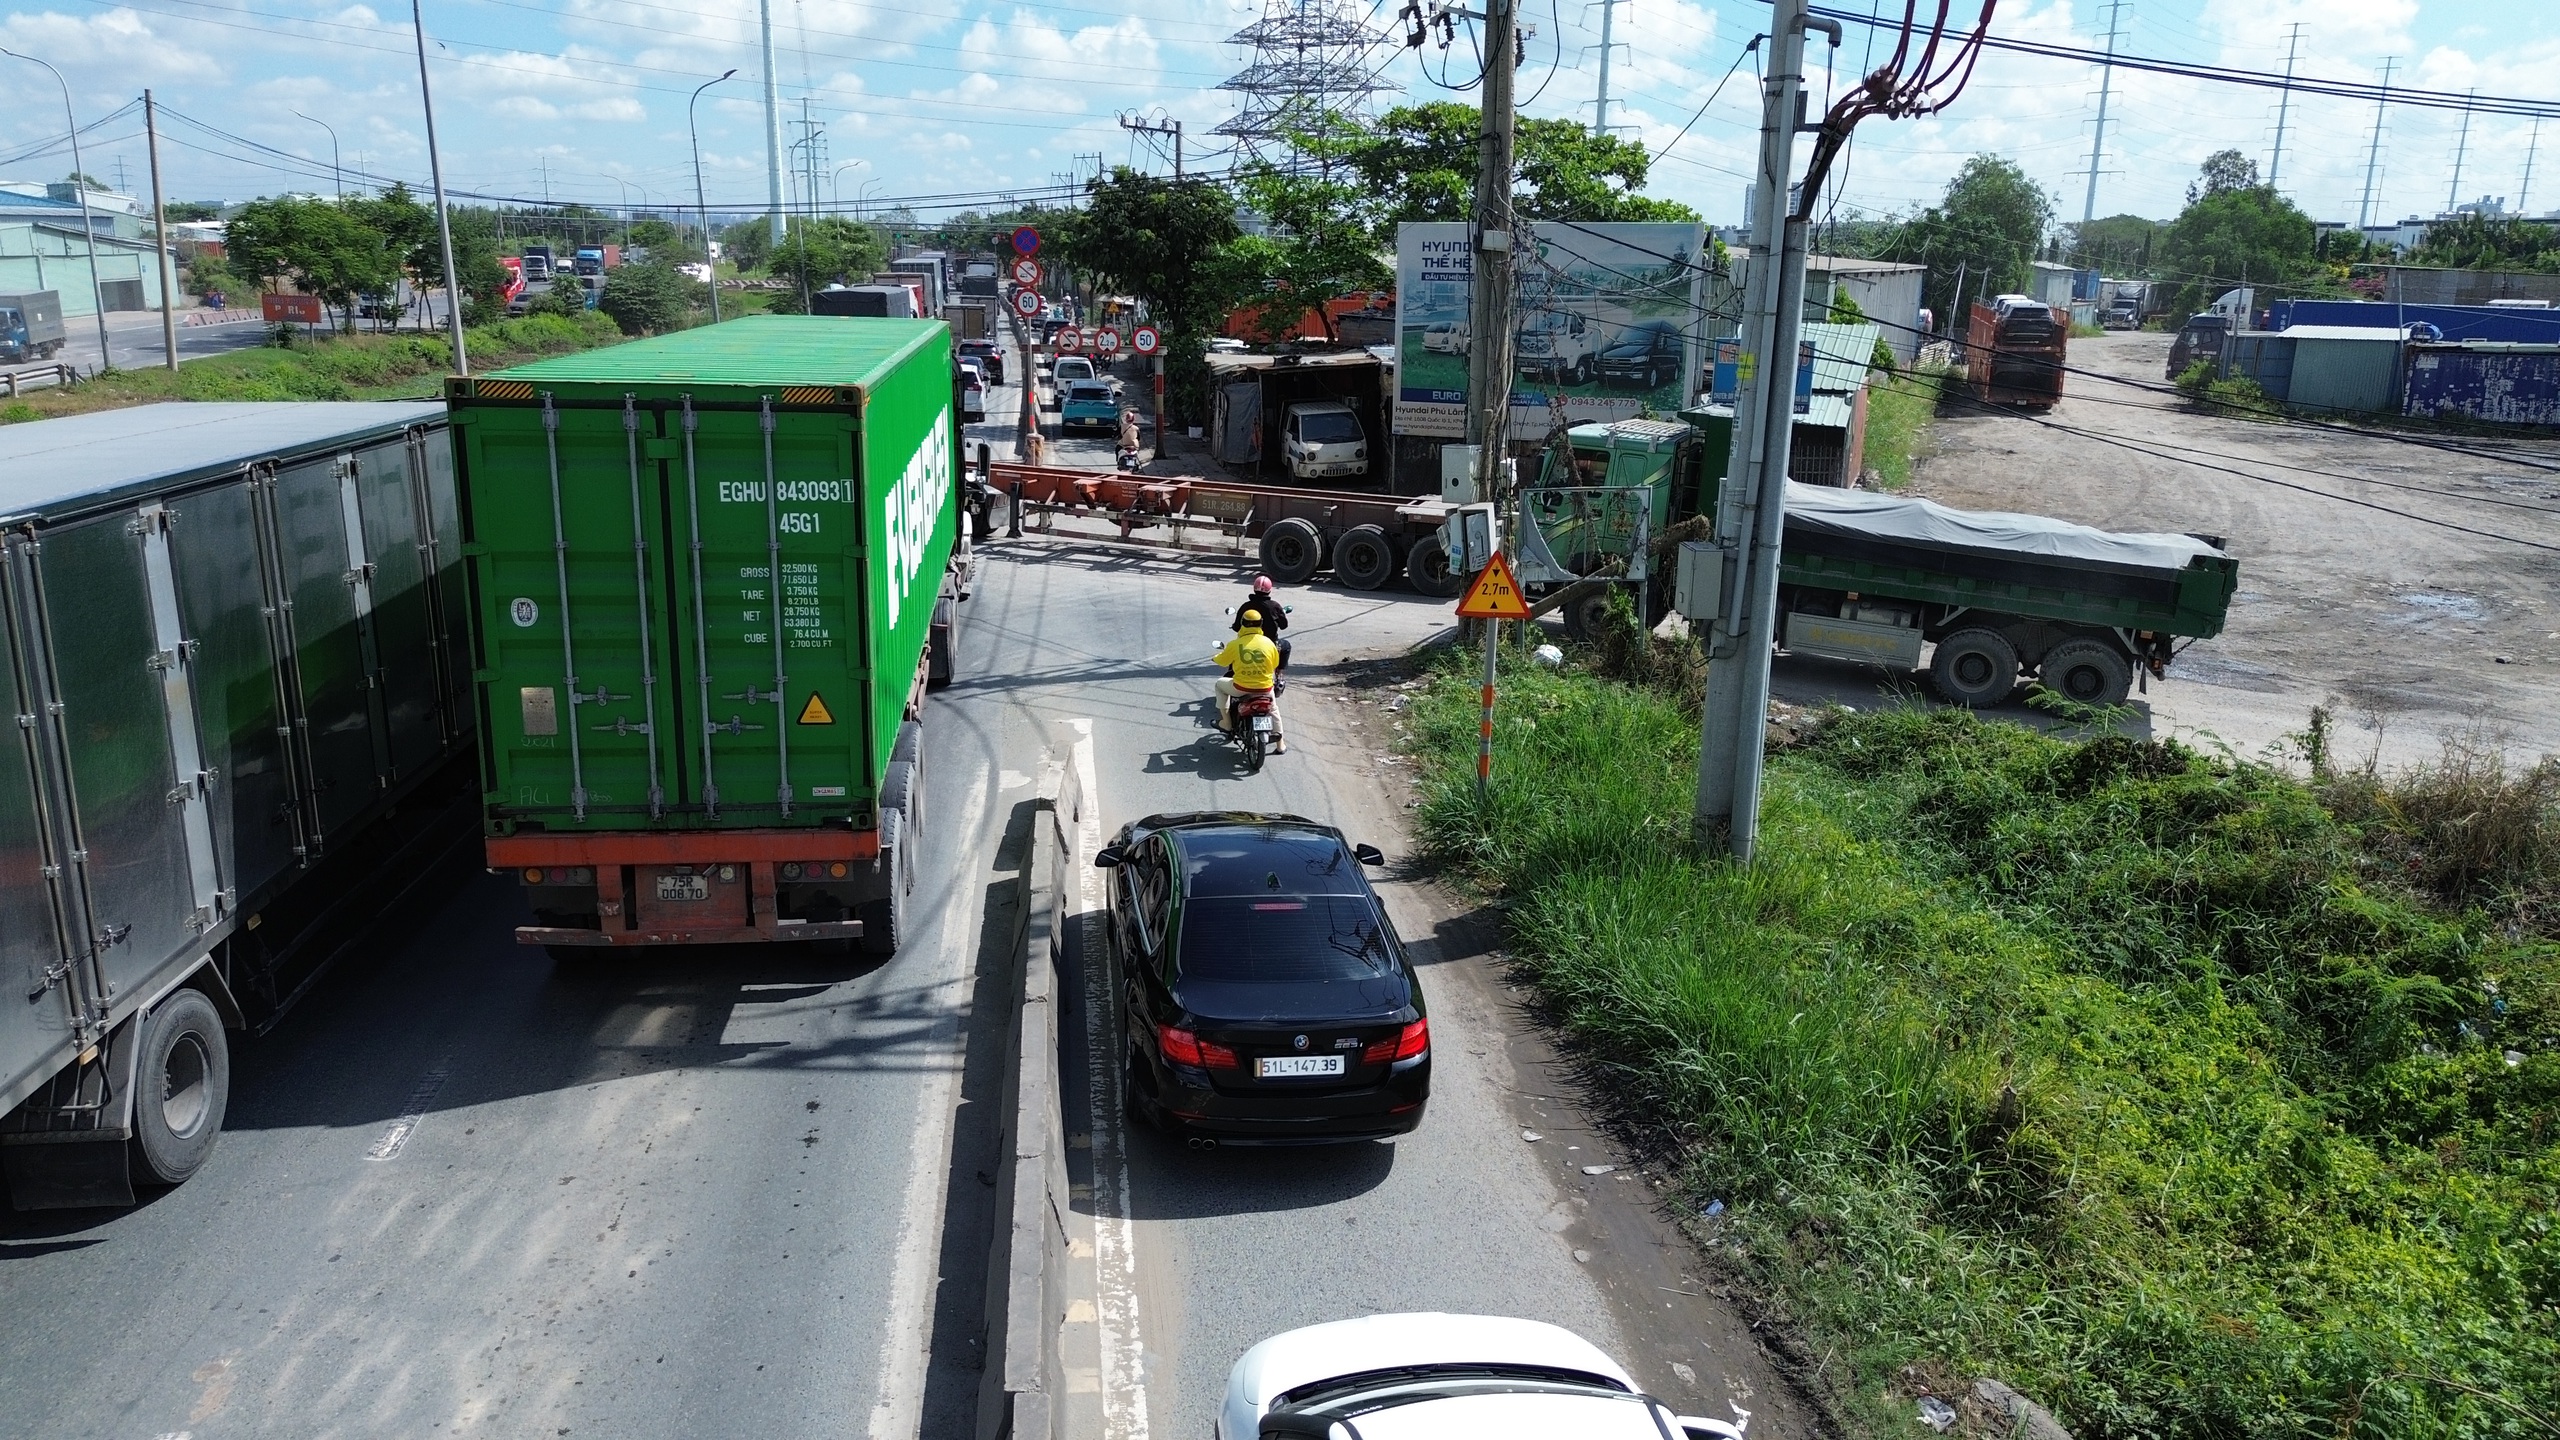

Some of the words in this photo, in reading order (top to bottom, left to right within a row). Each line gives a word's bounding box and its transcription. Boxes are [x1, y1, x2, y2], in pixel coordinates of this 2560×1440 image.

[1422, 241, 1473, 252] HYUND
[1422, 254, 1450, 268] THẾ
[1023, 296, 1034, 308] 60
[1140, 334, 1152, 346] 50
[1432, 391, 1461, 400] EURO
[1571, 397, 1595, 406] 0943
[1618, 399, 1636, 407] 779
[1395, 406, 1429, 414] Hyundai
[719, 481, 767, 503] EGHU
[779, 512, 820, 534] 45G1
[740, 567, 770, 578] GROSS
[781, 563, 807, 573] 32.500
[807, 563, 818, 573] KG
[782, 575, 807, 584] 71.650
[808, 575, 818, 584] LB
[741, 589, 765, 600] TARE
[786, 586, 808, 596] 3.750
[808, 586, 818, 596] KG
[787, 598, 808, 606] 8.270
[808, 598, 819, 606] LB
[743, 610, 761, 622] NET
[784, 607, 809, 616] 28.750
[810, 607, 820, 616] KG
[810, 618, 820, 627] LB
[743, 633, 768, 643] CUBE
[793, 629, 810, 639] 76.4
[810, 629, 829, 639] CU.M
[789, 640, 811, 648] 2.700
[811, 640, 833, 648] CU.FT
[1239, 643, 1266, 665] be
[671, 876, 694, 888] 75R
[662, 888, 703, 899] 008.70
[1262, 1059, 1338, 1073] 51L-147.39
